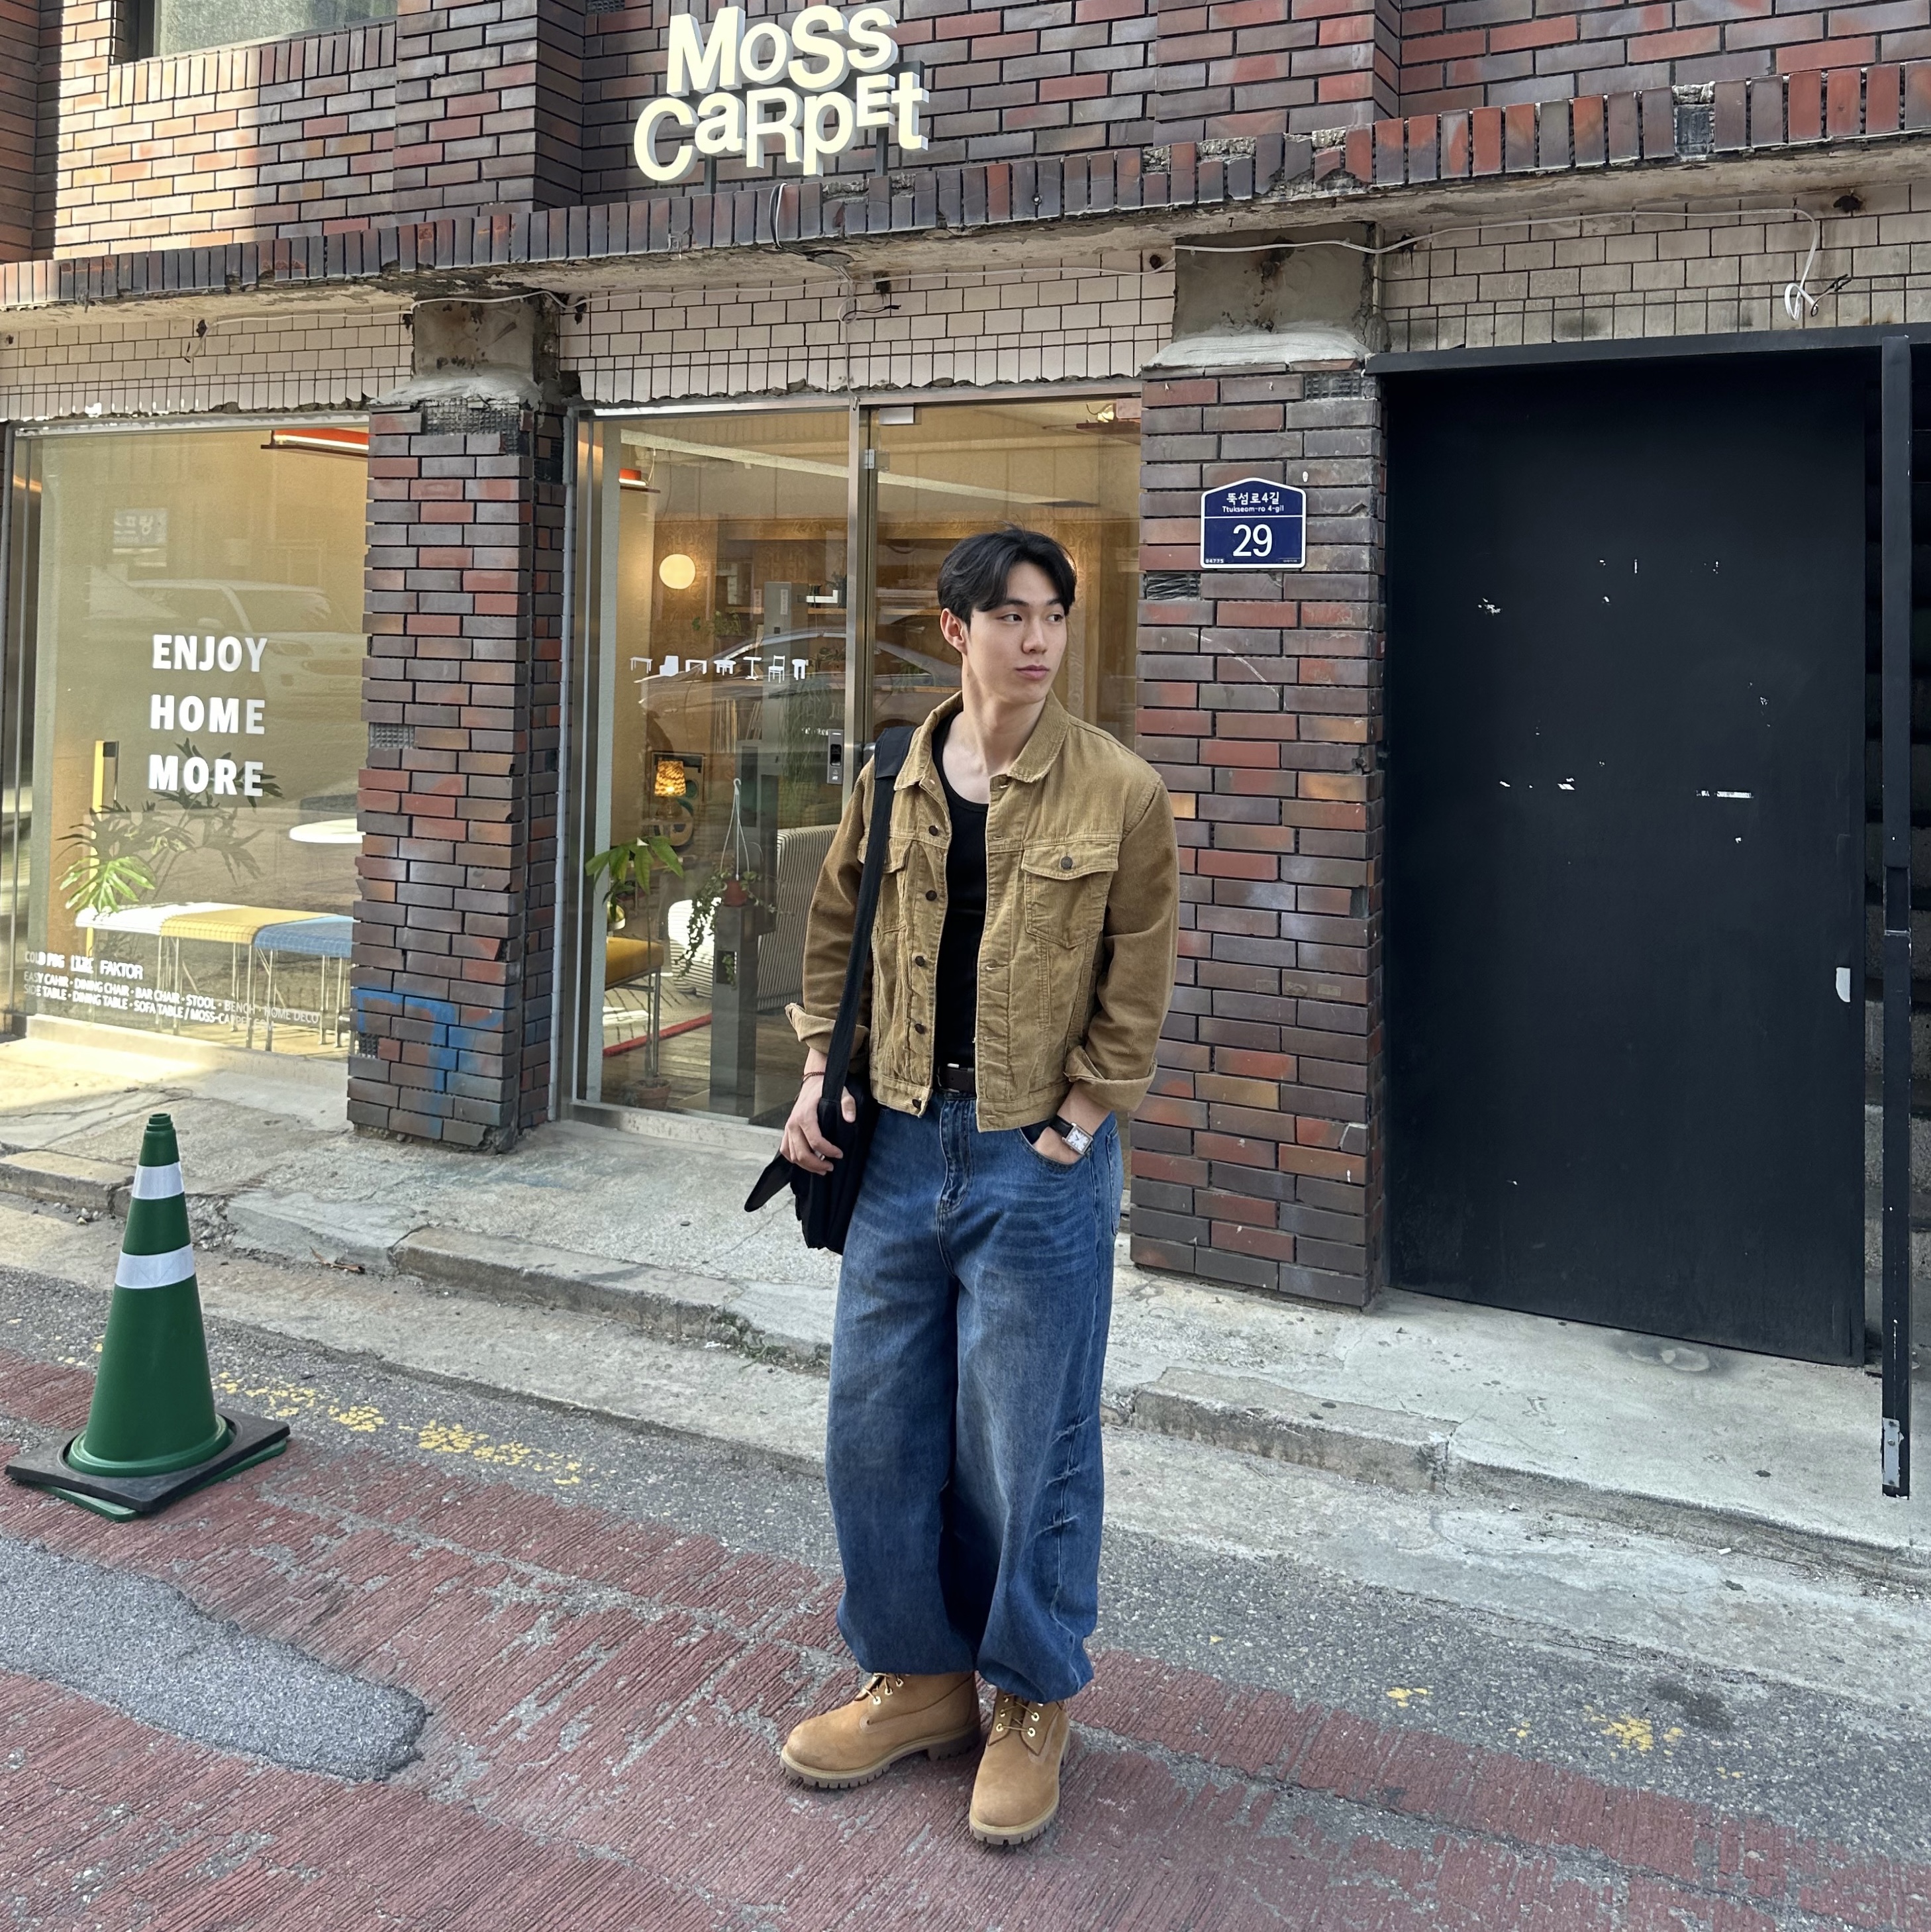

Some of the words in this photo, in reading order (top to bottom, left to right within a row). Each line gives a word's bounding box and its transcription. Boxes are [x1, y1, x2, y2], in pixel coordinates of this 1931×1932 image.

[1226, 491, 1279, 505] 뚝섬로4길
[1267, 505, 1284, 513] 4-gil
[1232, 524, 1273, 557] 29
[152, 634, 268, 672] ENJOY
[150, 694, 265, 735] HOME
[148, 754, 264, 797] MORE
[100, 960, 143, 980] FAKTOR
[24, 971, 44, 984] EASY
[74, 978, 103, 993] DINING
[104, 982, 130, 997] CHAIR
[135, 987, 153, 1000] BAR
[154, 990, 180, 1004] CHAIR
[186, 993, 217, 1009] STOOL
[224, 999, 256, 1015] BENCH
[264, 1005, 291, 1021] HOME
[293, 1010, 319, 1024] DECO
[24, 984, 42, 997] SIDE
[42, 986, 68, 1001] TABLE
[72, 991, 101, 1006] DINING
[101, 995, 128, 1010] TABLE
[134, 999, 156, 1014] SOFA
[157, 1003, 184, 1019] TABLE
